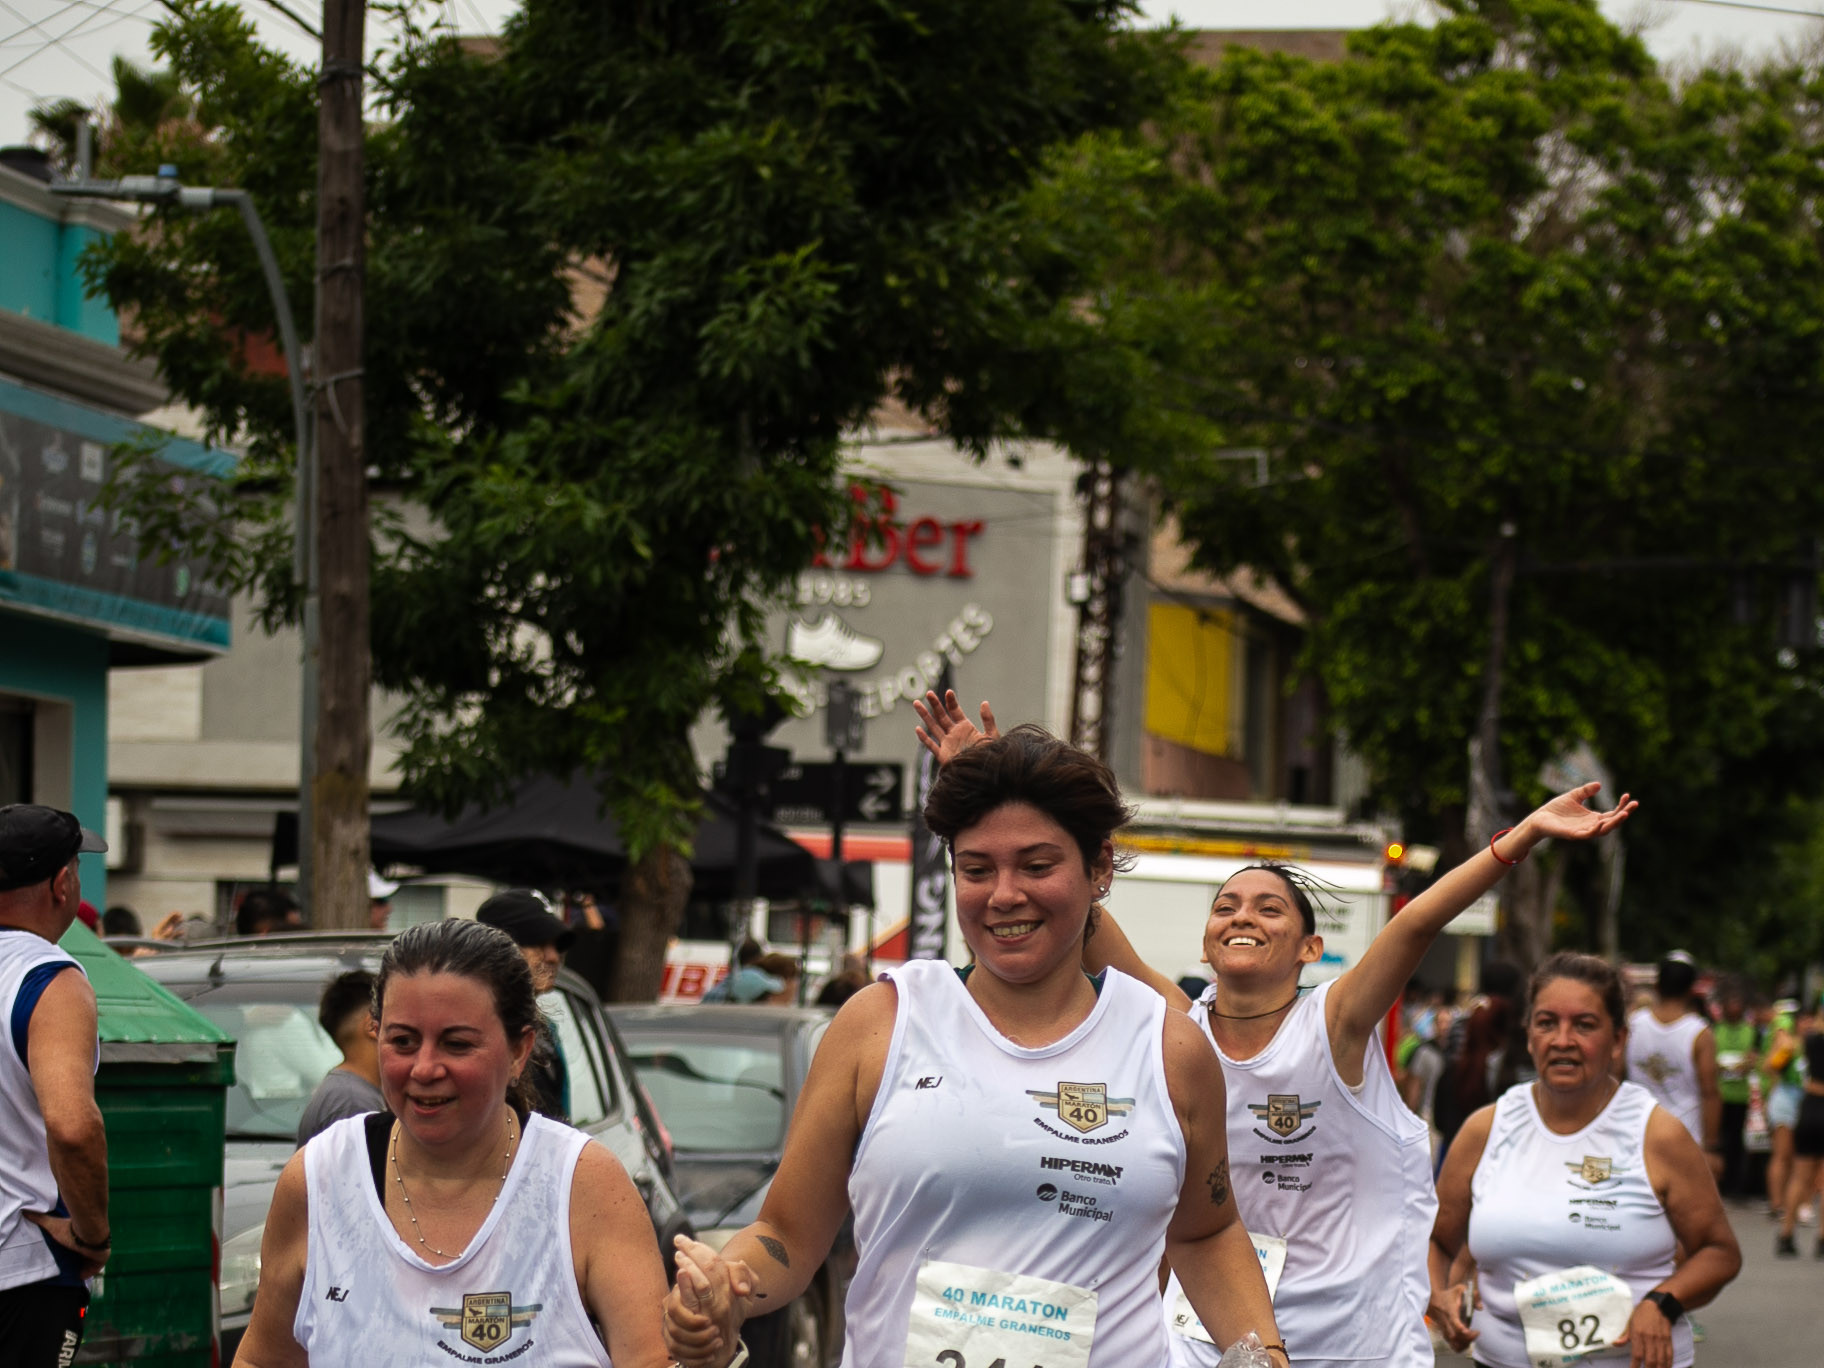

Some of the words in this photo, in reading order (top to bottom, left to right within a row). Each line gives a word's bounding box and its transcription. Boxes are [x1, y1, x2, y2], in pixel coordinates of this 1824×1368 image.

[1063, 1086, 1102, 1094] ARGENTINA
[1069, 1107, 1098, 1123] 40
[1274, 1117, 1294, 1129] 40
[1033, 1117, 1080, 1144] EMPALME
[1081, 1129, 1130, 1146] GRANEROS
[1074, 1172, 1092, 1183] Otro
[1277, 1174, 1300, 1183] Banco
[1060, 1190, 1097, 1206] Banco
[1057, 1202, 1114, 1222] Municipal
[1549, 1274, 1609, 1293] MARATON
[468, 1297, 506, 1306] ARGENTINA
[942, 1286, 964, 1303] 40
[970, 1291, 1068, 1322] MARATON
[472, 1323, 501, 1341] 40
[934, 1307, 995, 1327] EMPALME
[999, 1319, 1071, 1341] GRANEROS
[1557, 1314, 1605, 1351] 82
[436, 1340, 483, 1365] EMPALME
[484, 1338, 535, 1365] GRANEROS
